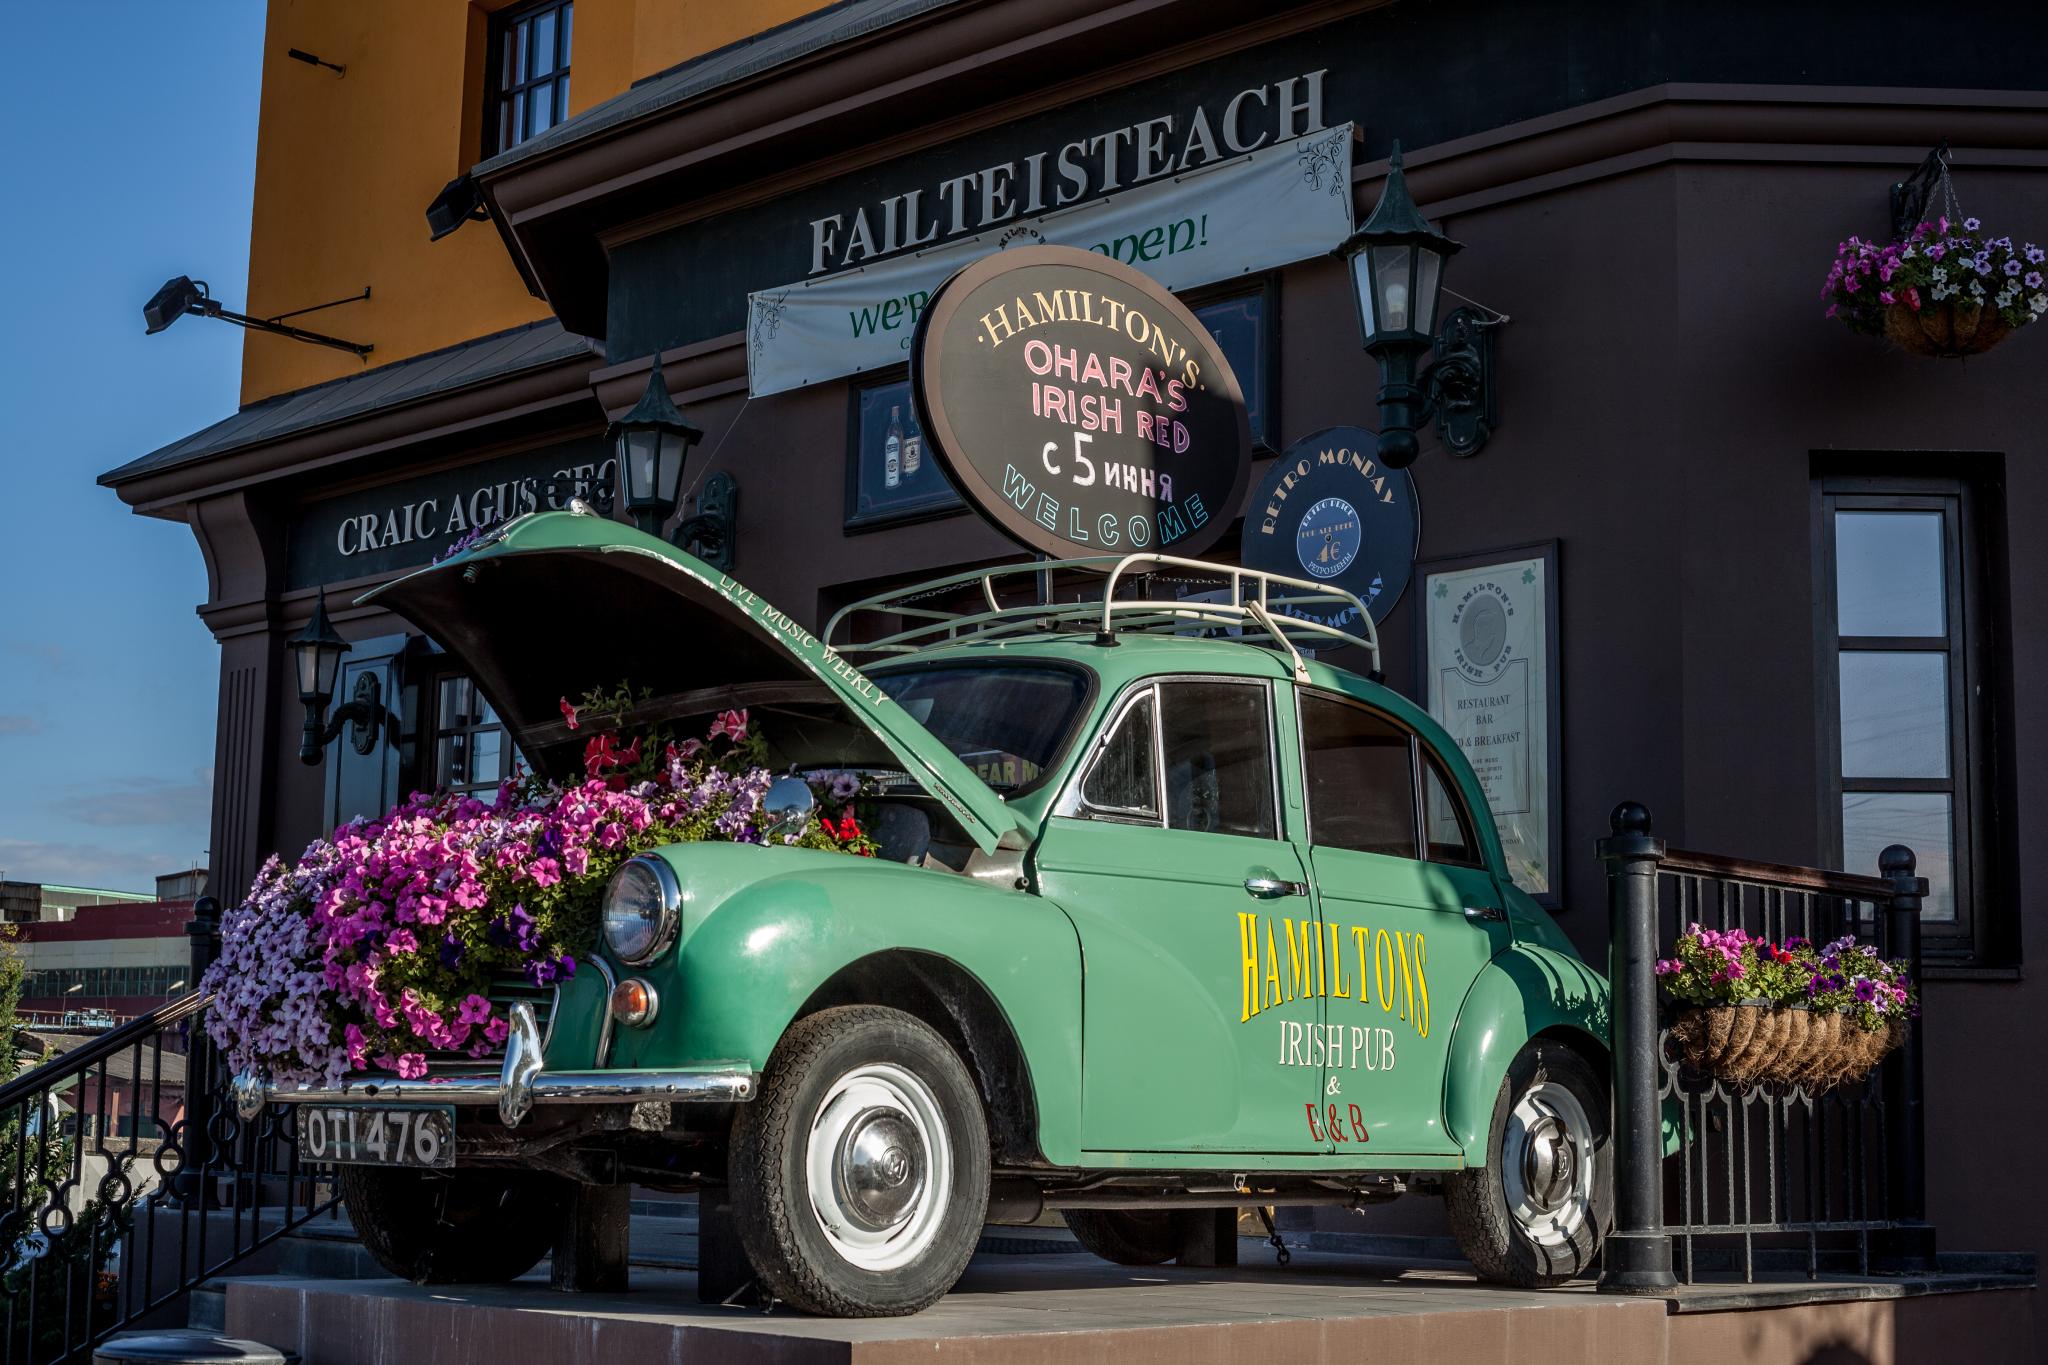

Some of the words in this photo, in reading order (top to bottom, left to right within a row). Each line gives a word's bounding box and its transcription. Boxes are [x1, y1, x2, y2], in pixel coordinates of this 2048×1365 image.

[1024, 339, 1188, 412] OHARA'S
[1031, 382, 1123, 434] IRISH
[1137, 410, 1191, 454] RED
[1072, 431, 1096, 487] 5
[337, 499, 438, 557] CRAIC
[445, 477, 538, 535] AGUS
[1003, 463, 1209, 546] WELCOME
[1261, 459, 1311, 535] RETRO
[1318, 448, 1396, 504] MONDAY
[1452, 582, 1514, 625] HAMILTON'S
[719, 574, 759, 606] LIVE
[761, 604, 819, 648] MUSIC
[822, 645, 890, 707] WEEKLY
[1454, 648, 1484, 678] IRISH
[1494, 645, 1512, 672] PUB
[1457, 694, 1511, 710] RESTAURANT
[1476, 714, 1494, 725] BAR
[1465, 736, 1472, 747] &
[1474, 731, 1521, 747] BREAKFAST
[968, 761, 1016, 785] EAR
[1237, 912, 1430, 1039] HAMILTONS
[1278, 1020, 1344, 1068] IRISH
[1350, 1026, 1396, 1071] PUB
[1326, 1075, 1341, 1095] &
[366, 1111, 439, 1165] 476
